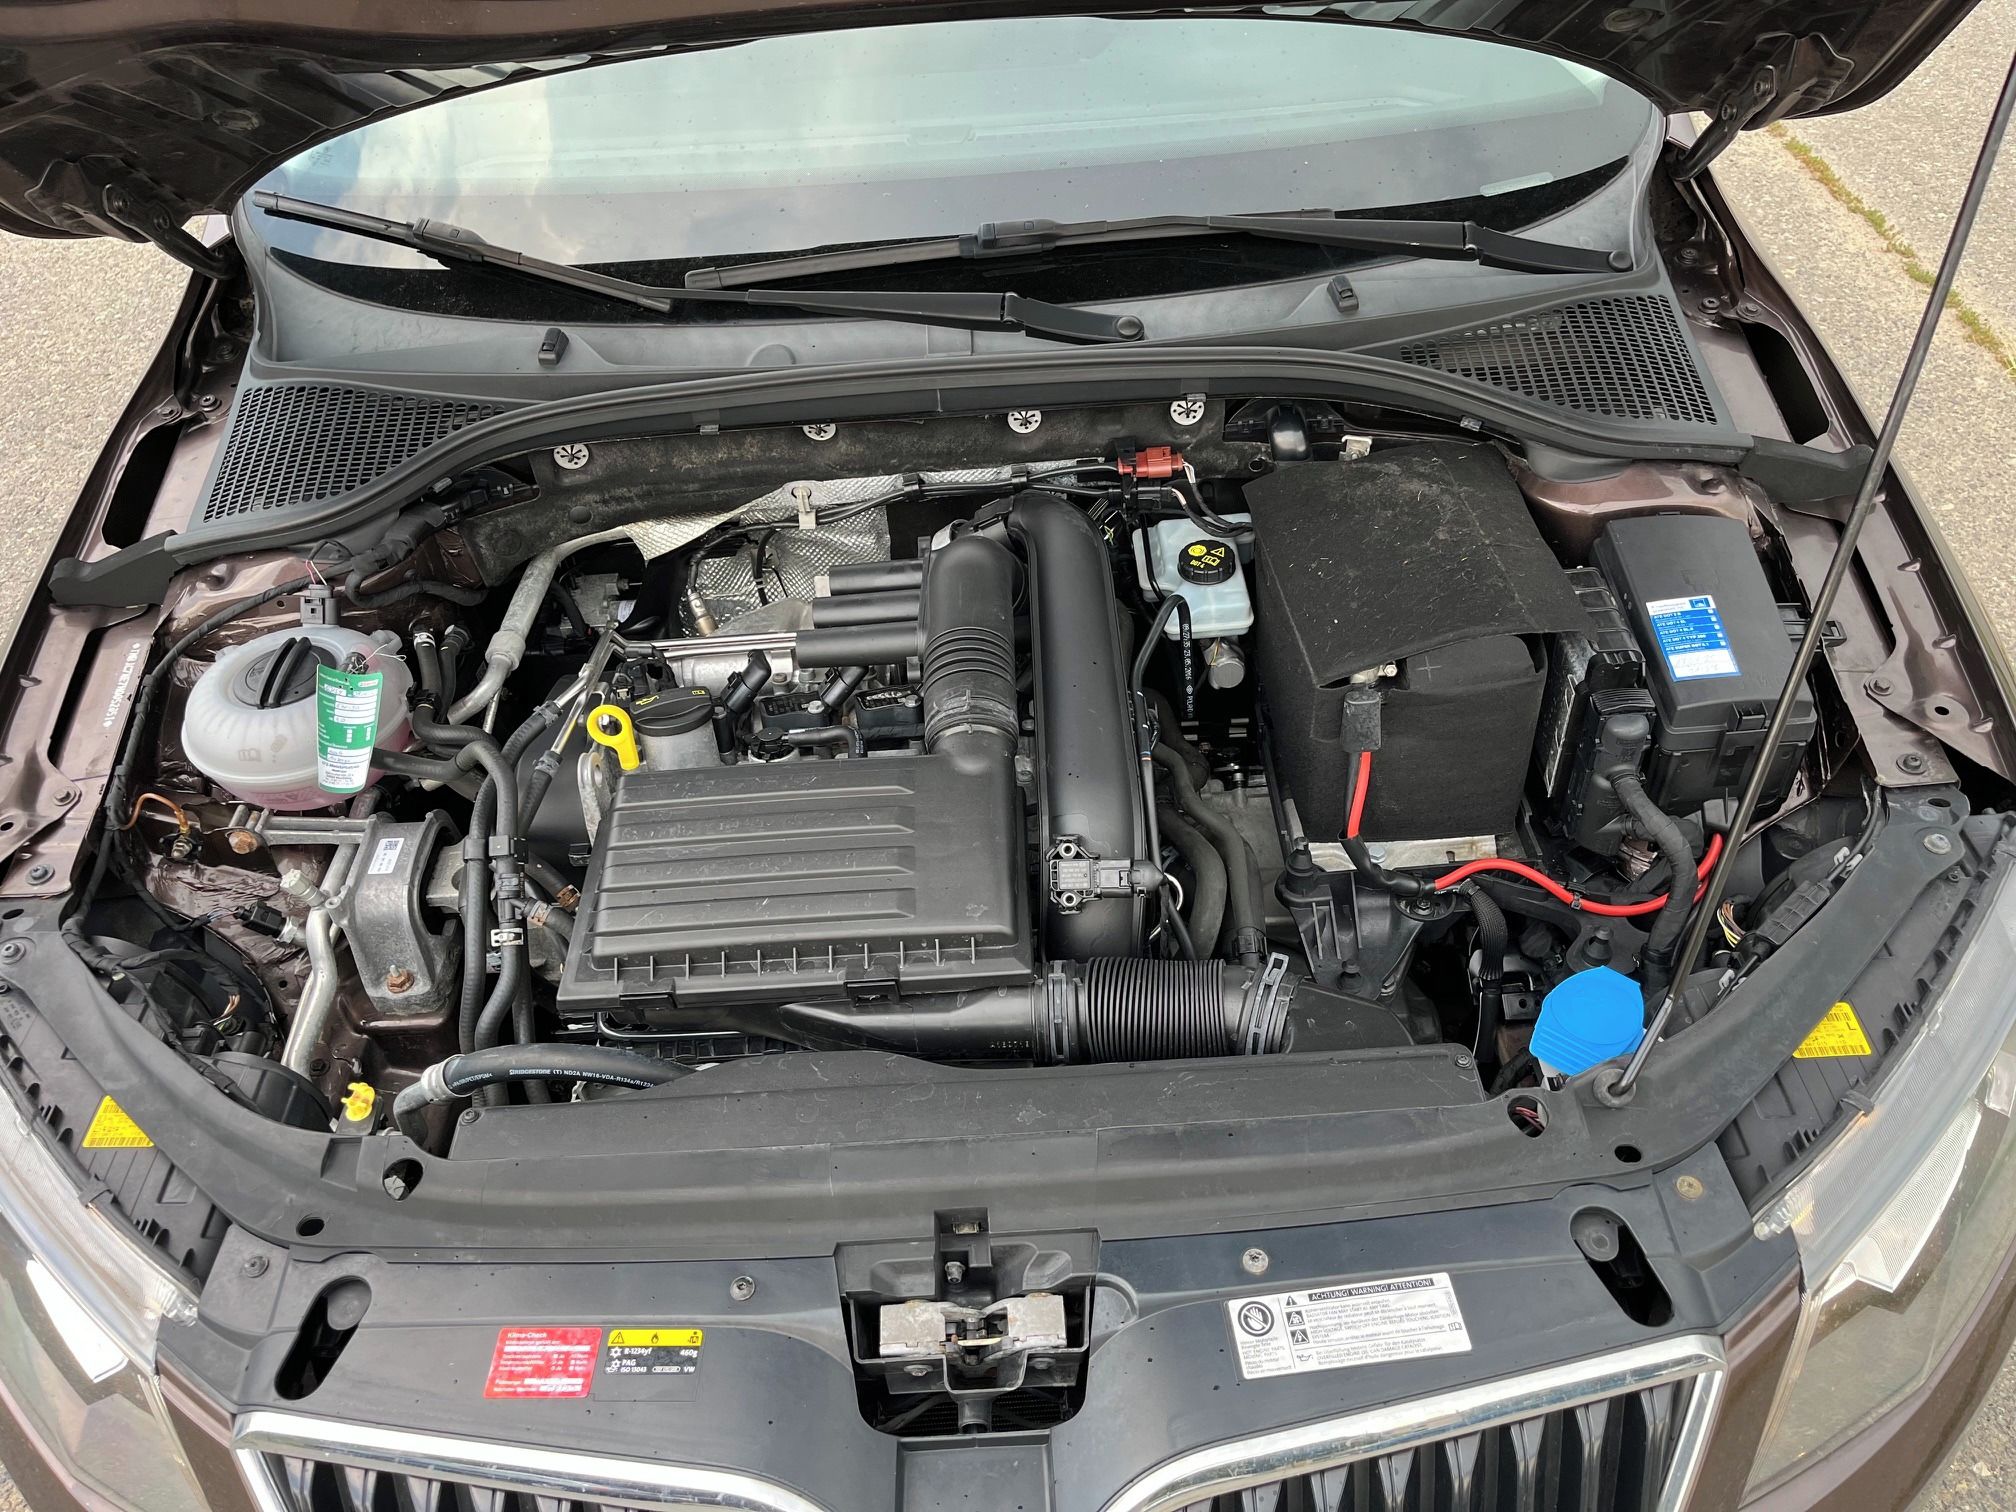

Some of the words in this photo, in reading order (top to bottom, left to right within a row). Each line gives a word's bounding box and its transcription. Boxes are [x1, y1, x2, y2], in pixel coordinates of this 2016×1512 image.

[1190, 559, 1201, 567] DOT
[1310, 1289, 1349, 1300] ACHTUNG!
[1350, 1284, 1388, 1295] WARNING!
[1388, 1278, 1431, 1290] ATTENTION!
[624, 1347, 653, 1356] R-1234yf
[680, 1349, 698, 1358] 460g
